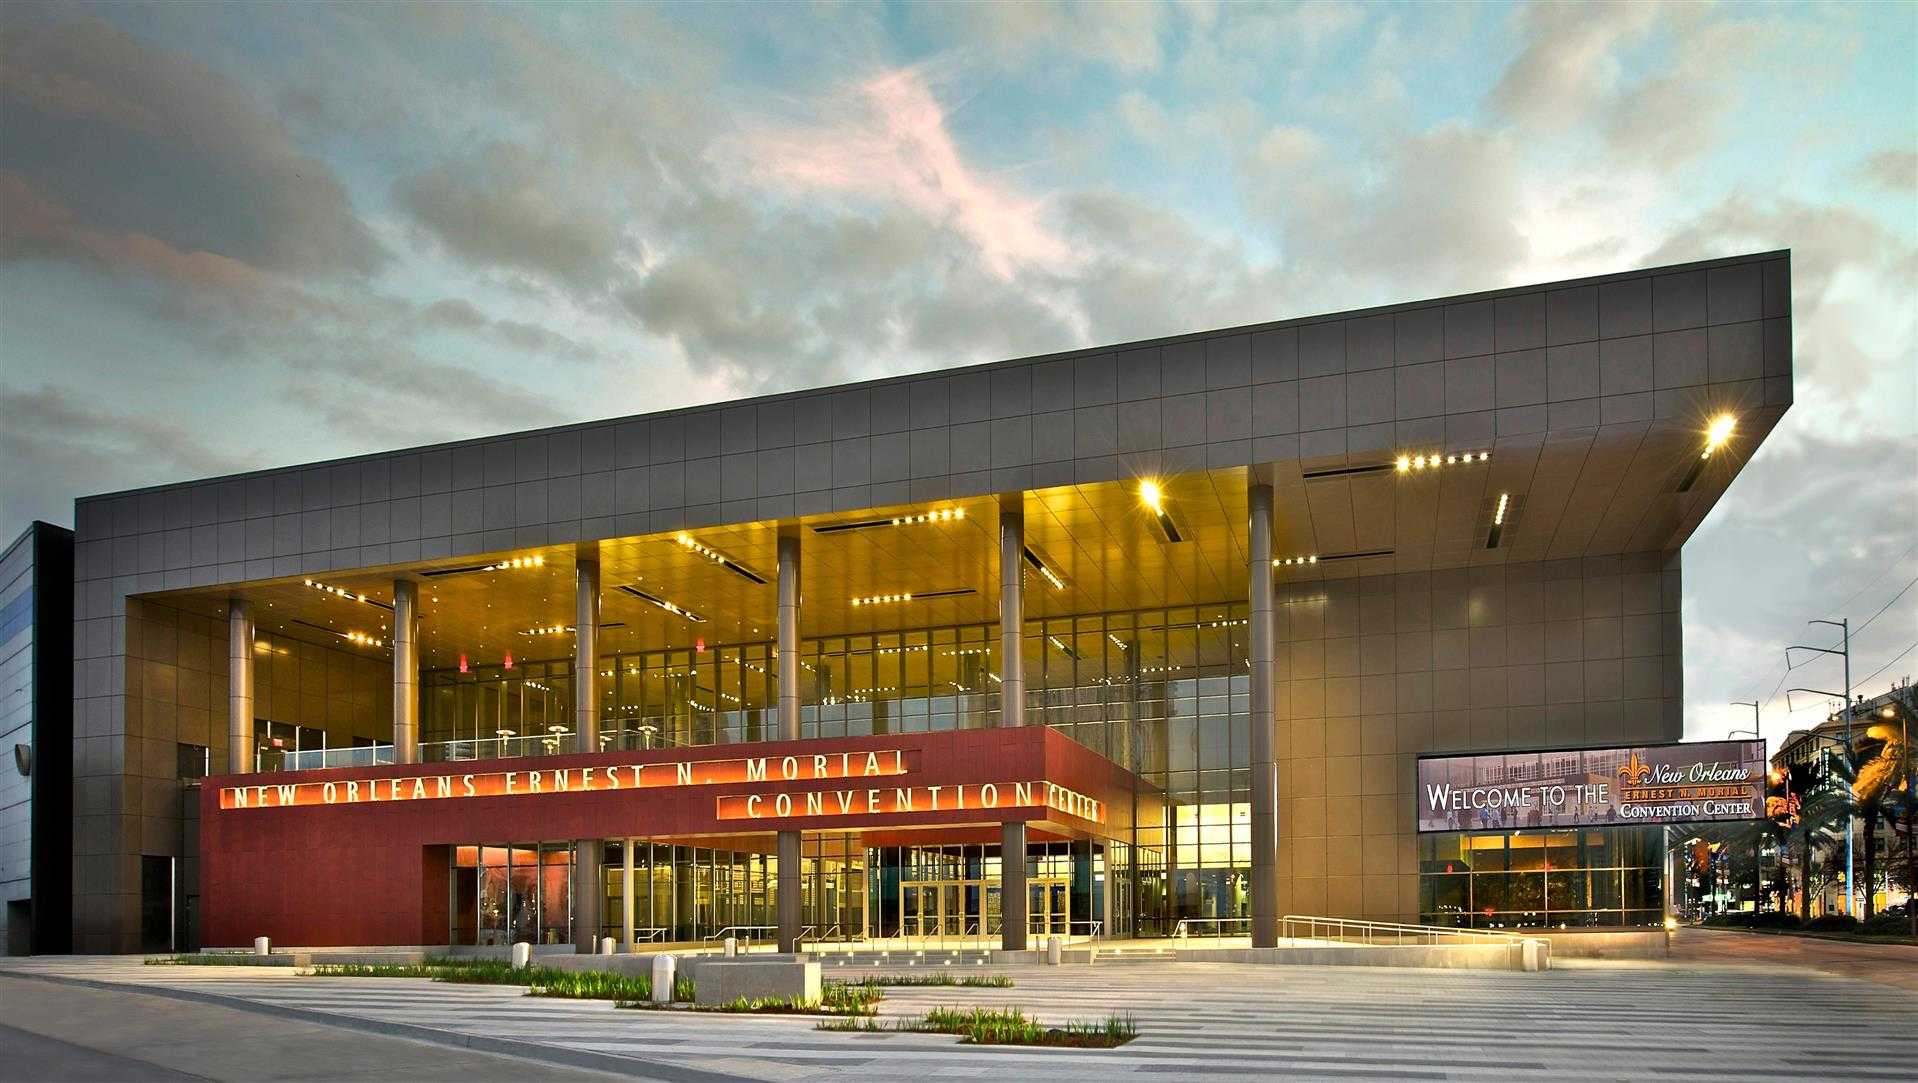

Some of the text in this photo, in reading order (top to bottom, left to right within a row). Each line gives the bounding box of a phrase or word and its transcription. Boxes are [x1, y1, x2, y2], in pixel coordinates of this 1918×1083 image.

[234, 750, 908, 809] NEW ORLEANS ERNEST N. MORIAL
[1644, 761, 1750, 784] New Orleans
[747, 782, 1098, 822] CONVENTION CENTER
[1426, 783, 1608, 811] WELCOME TO THE
[1624, 786, 1749, 800] ERNEST N. MORIAL
[1620, 800, 1751, 818] CONVENTION CENTER
